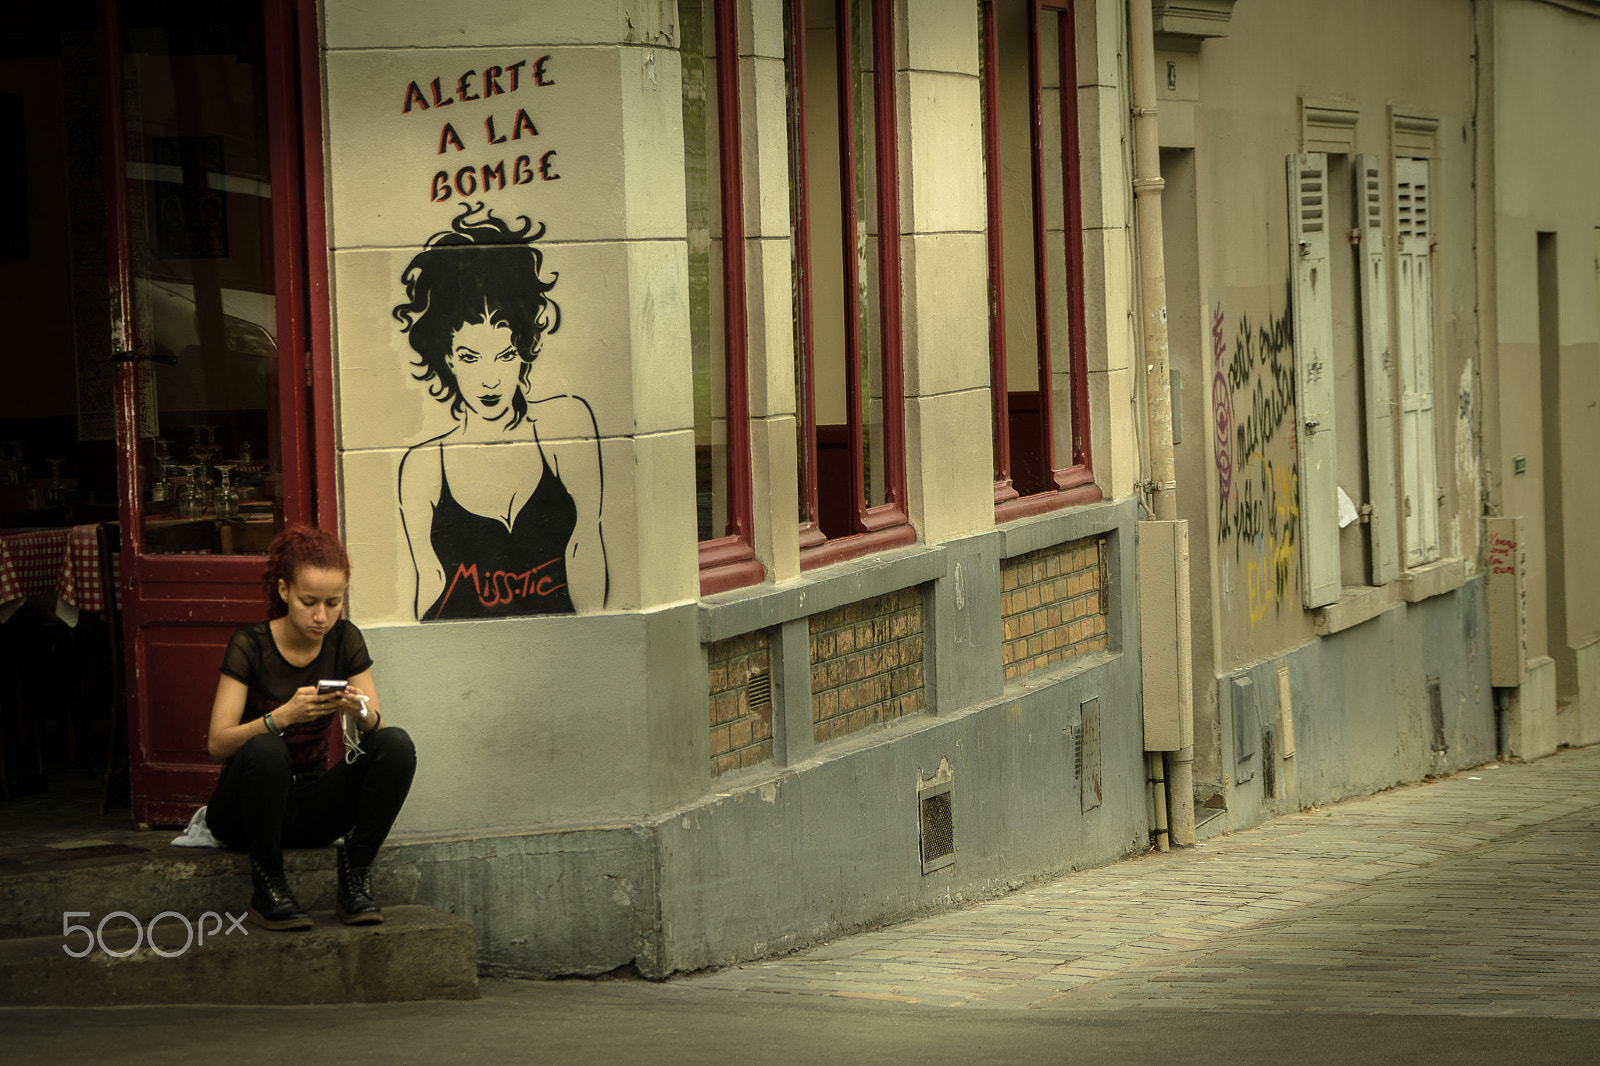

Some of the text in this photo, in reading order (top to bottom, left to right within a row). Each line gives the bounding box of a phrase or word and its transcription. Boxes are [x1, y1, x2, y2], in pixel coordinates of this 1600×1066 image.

[402, 55, 556, 114] ALERTE
[437, 108, 539, 155] A LA
[430, 150, 561, 203] BOMBE
